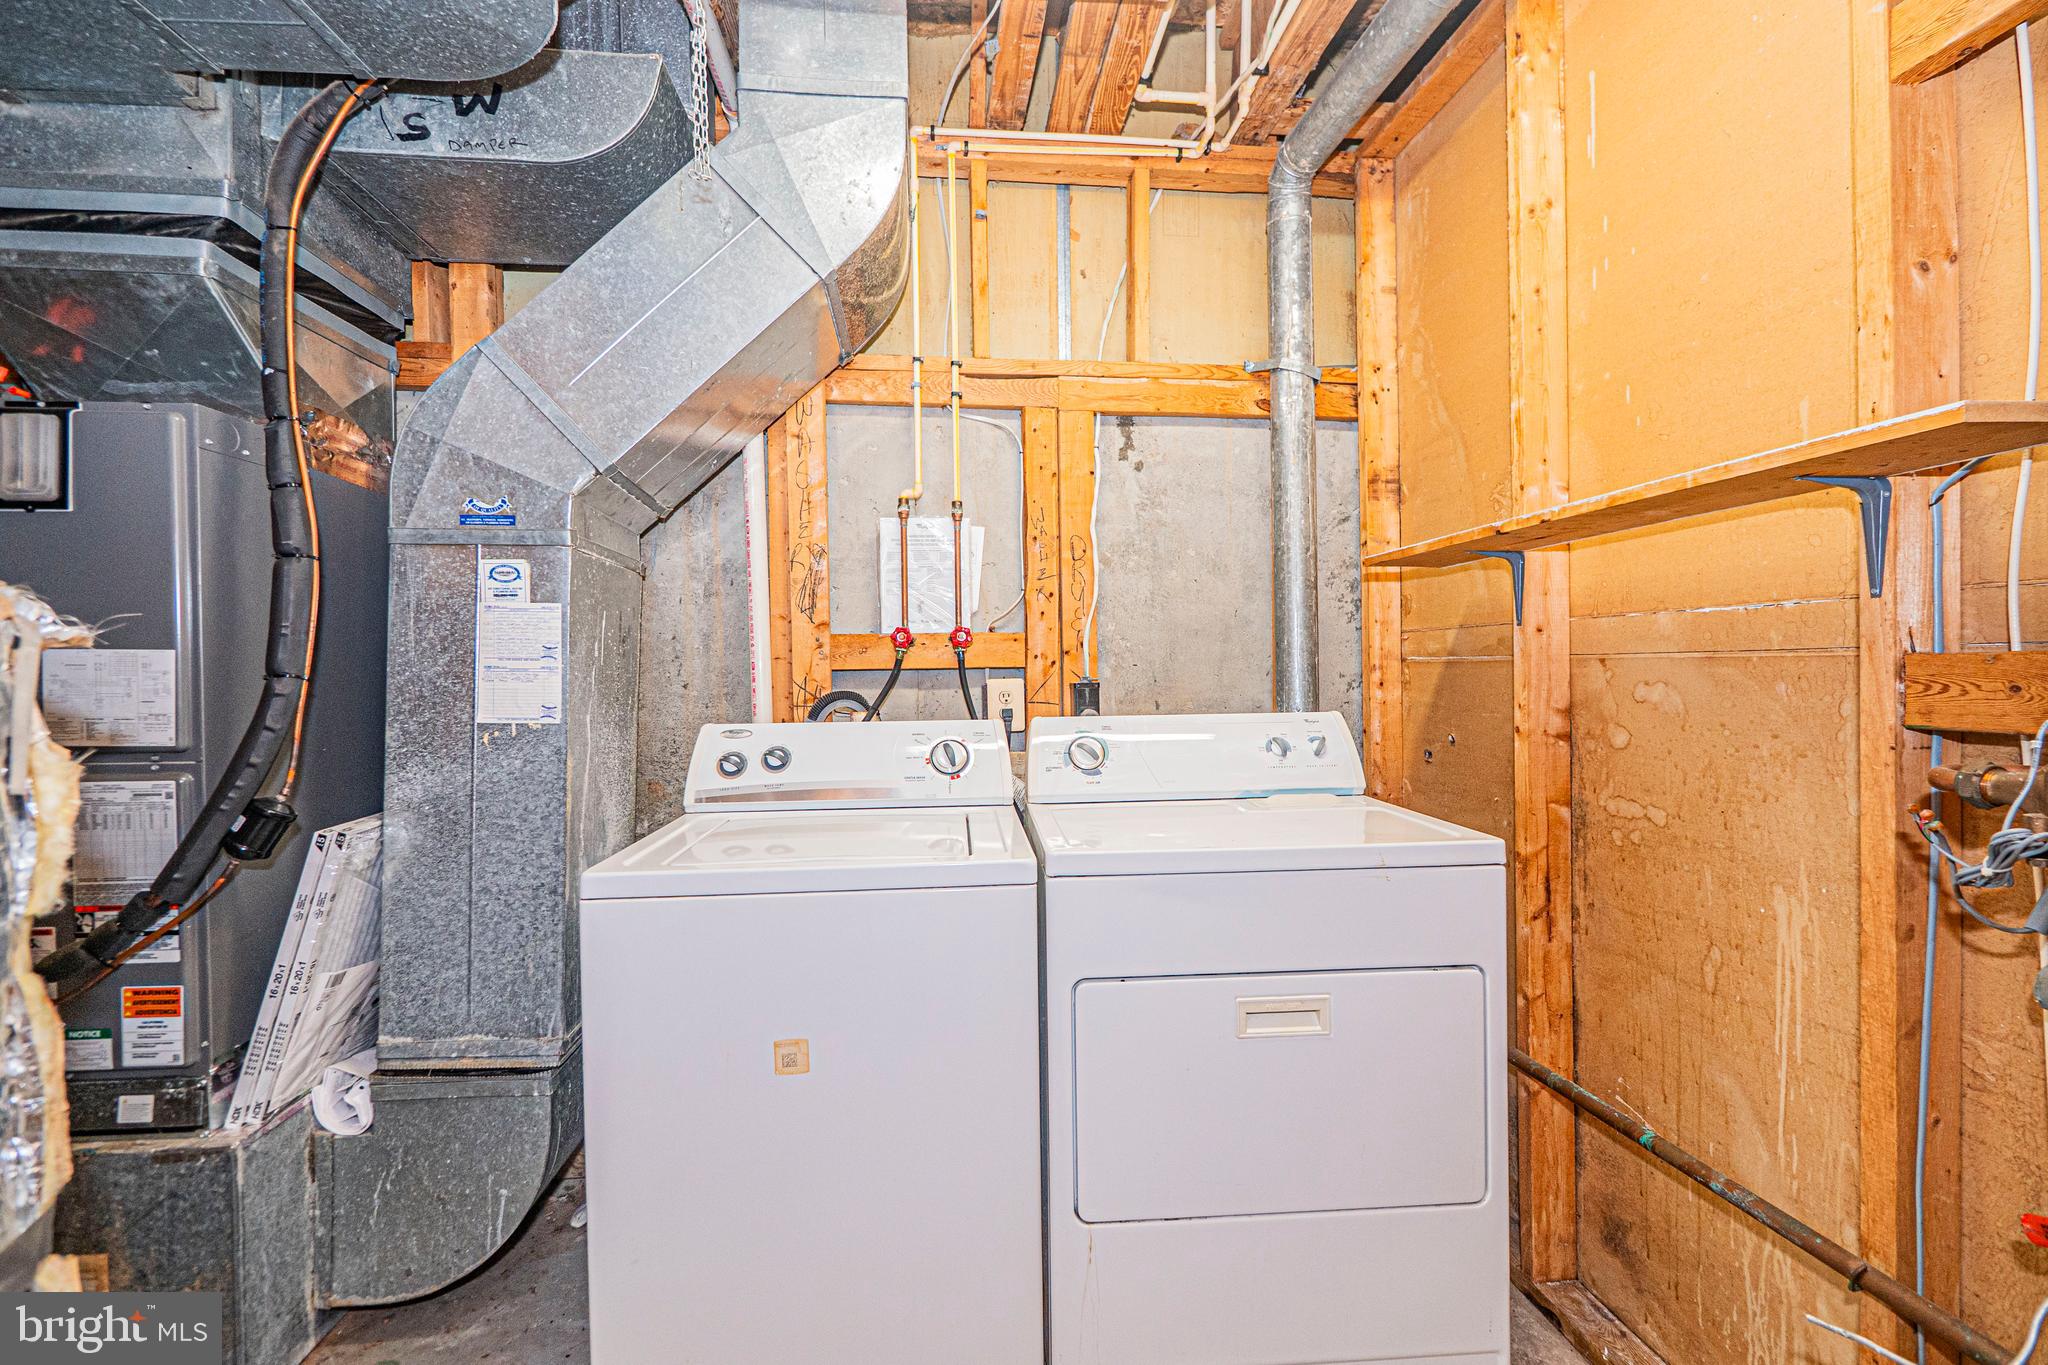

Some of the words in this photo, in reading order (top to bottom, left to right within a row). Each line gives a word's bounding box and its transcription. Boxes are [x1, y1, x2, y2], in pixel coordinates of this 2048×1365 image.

[452, 82, 503, 117] W
[396, 112, 432, 142] S
[448, 138, 529, 152] DAMPER
[68, 1030, 102, 1038] NOTICE
